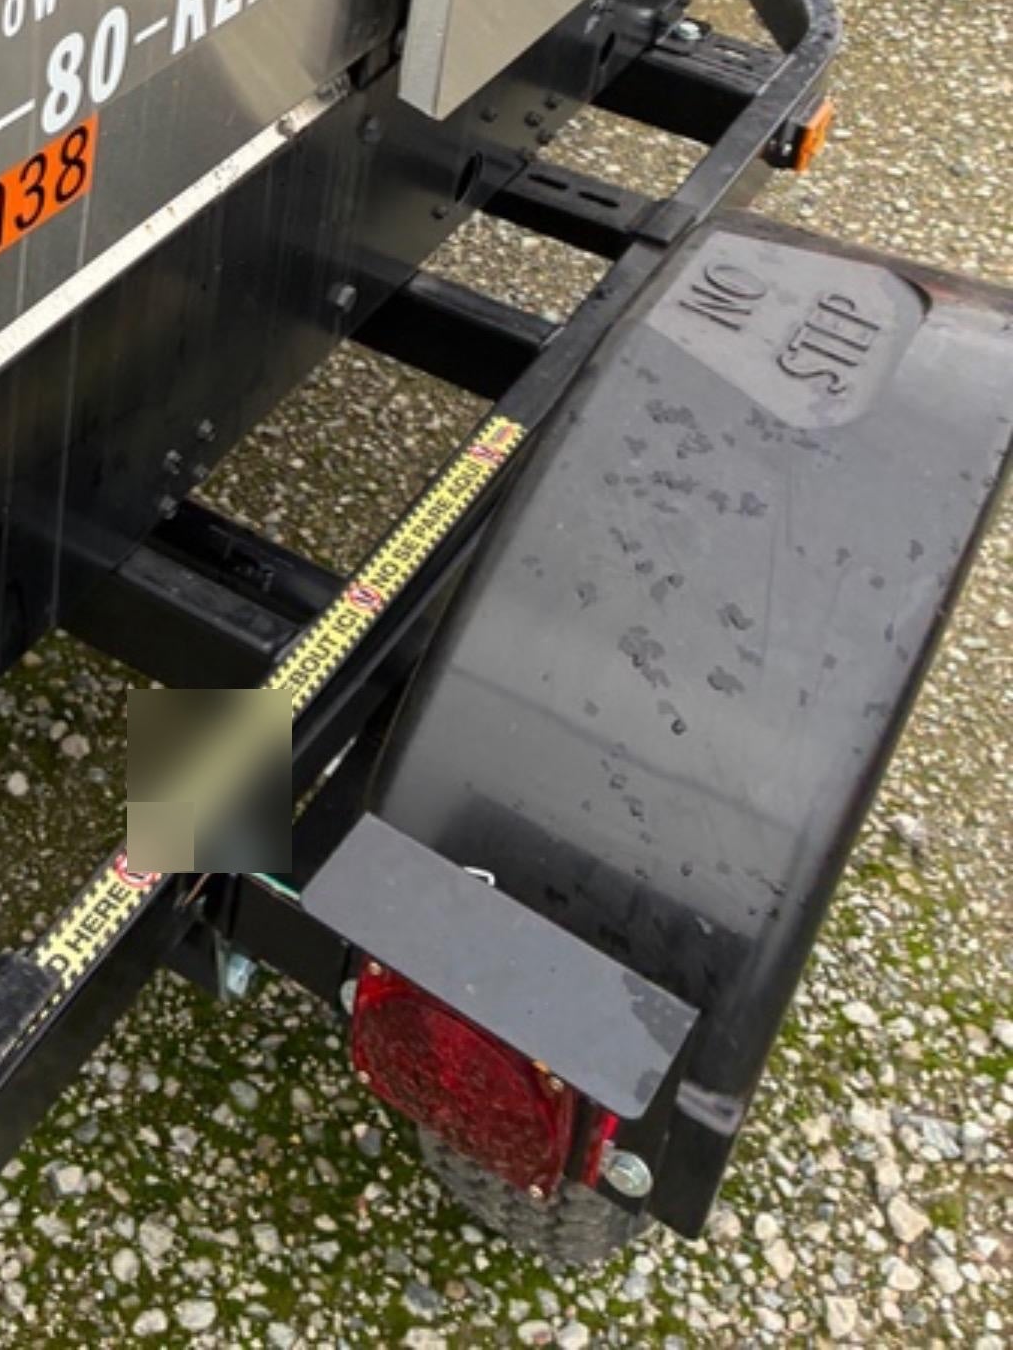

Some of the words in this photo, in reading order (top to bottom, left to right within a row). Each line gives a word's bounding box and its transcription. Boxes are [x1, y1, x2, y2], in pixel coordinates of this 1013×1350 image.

[678, 263, 768, 332] NO
[775, 292, 882, 396] STEP
[369, 561, 399, 588] NO
[65, 882, 132, 954] HERE
